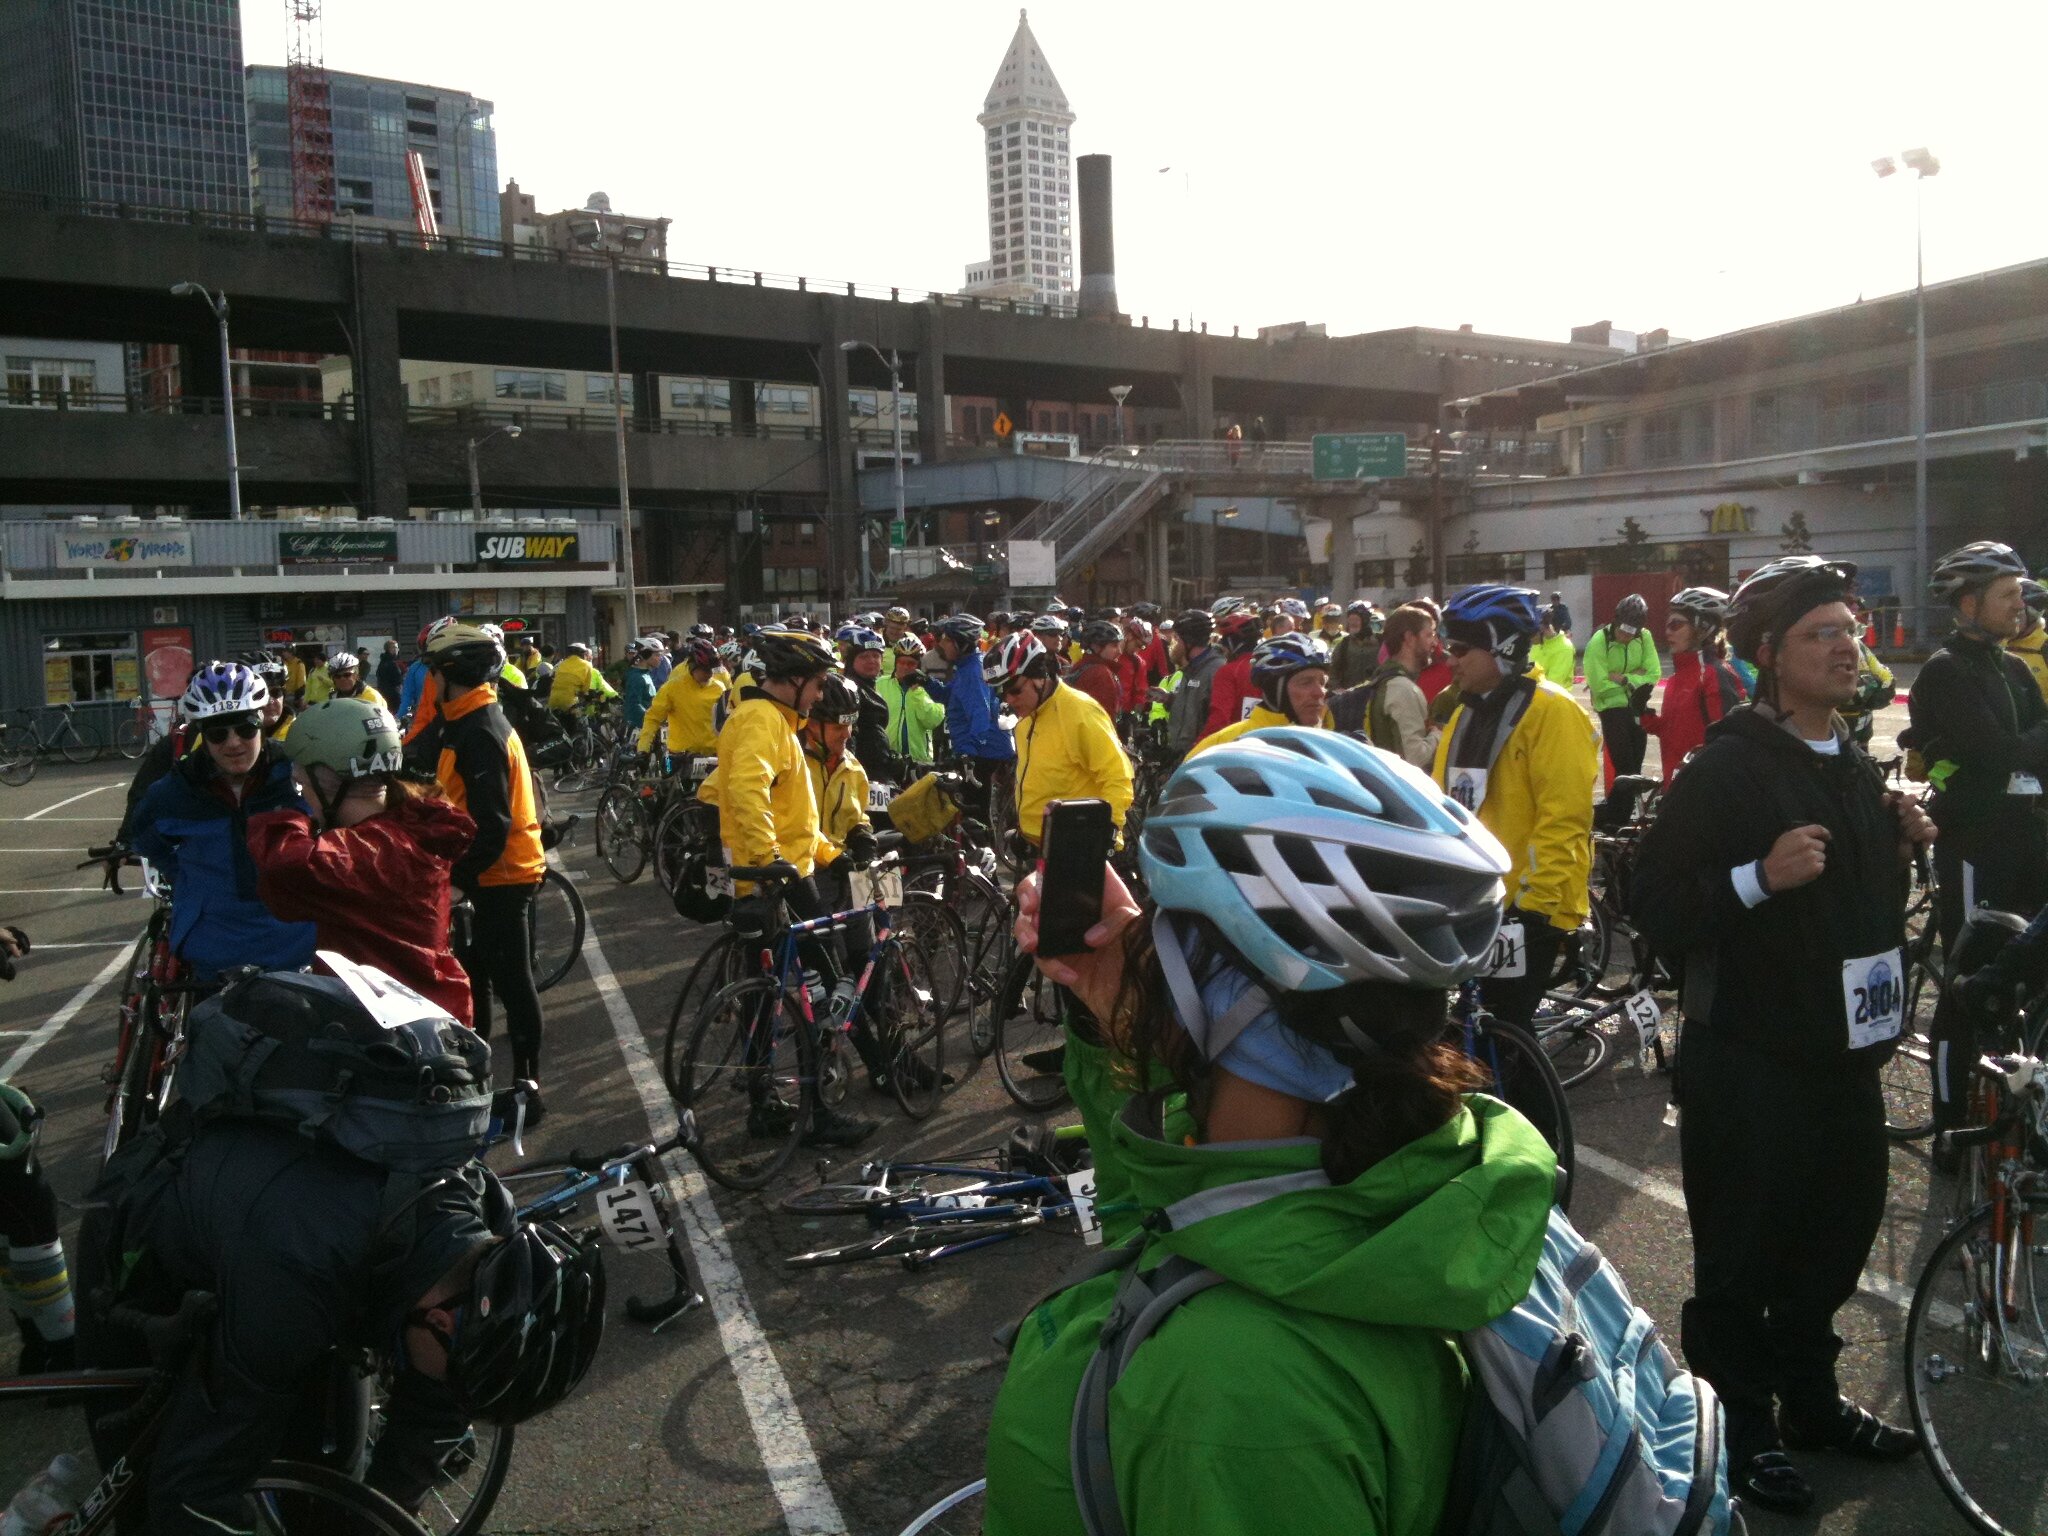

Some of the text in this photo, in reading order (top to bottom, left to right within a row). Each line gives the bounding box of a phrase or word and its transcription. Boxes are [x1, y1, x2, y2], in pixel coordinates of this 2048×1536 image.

[480, 536, 576, 559] SUBWAY
[211, 700, 242, 713] 1187
[606, 1188, 656, 1249] 1471
